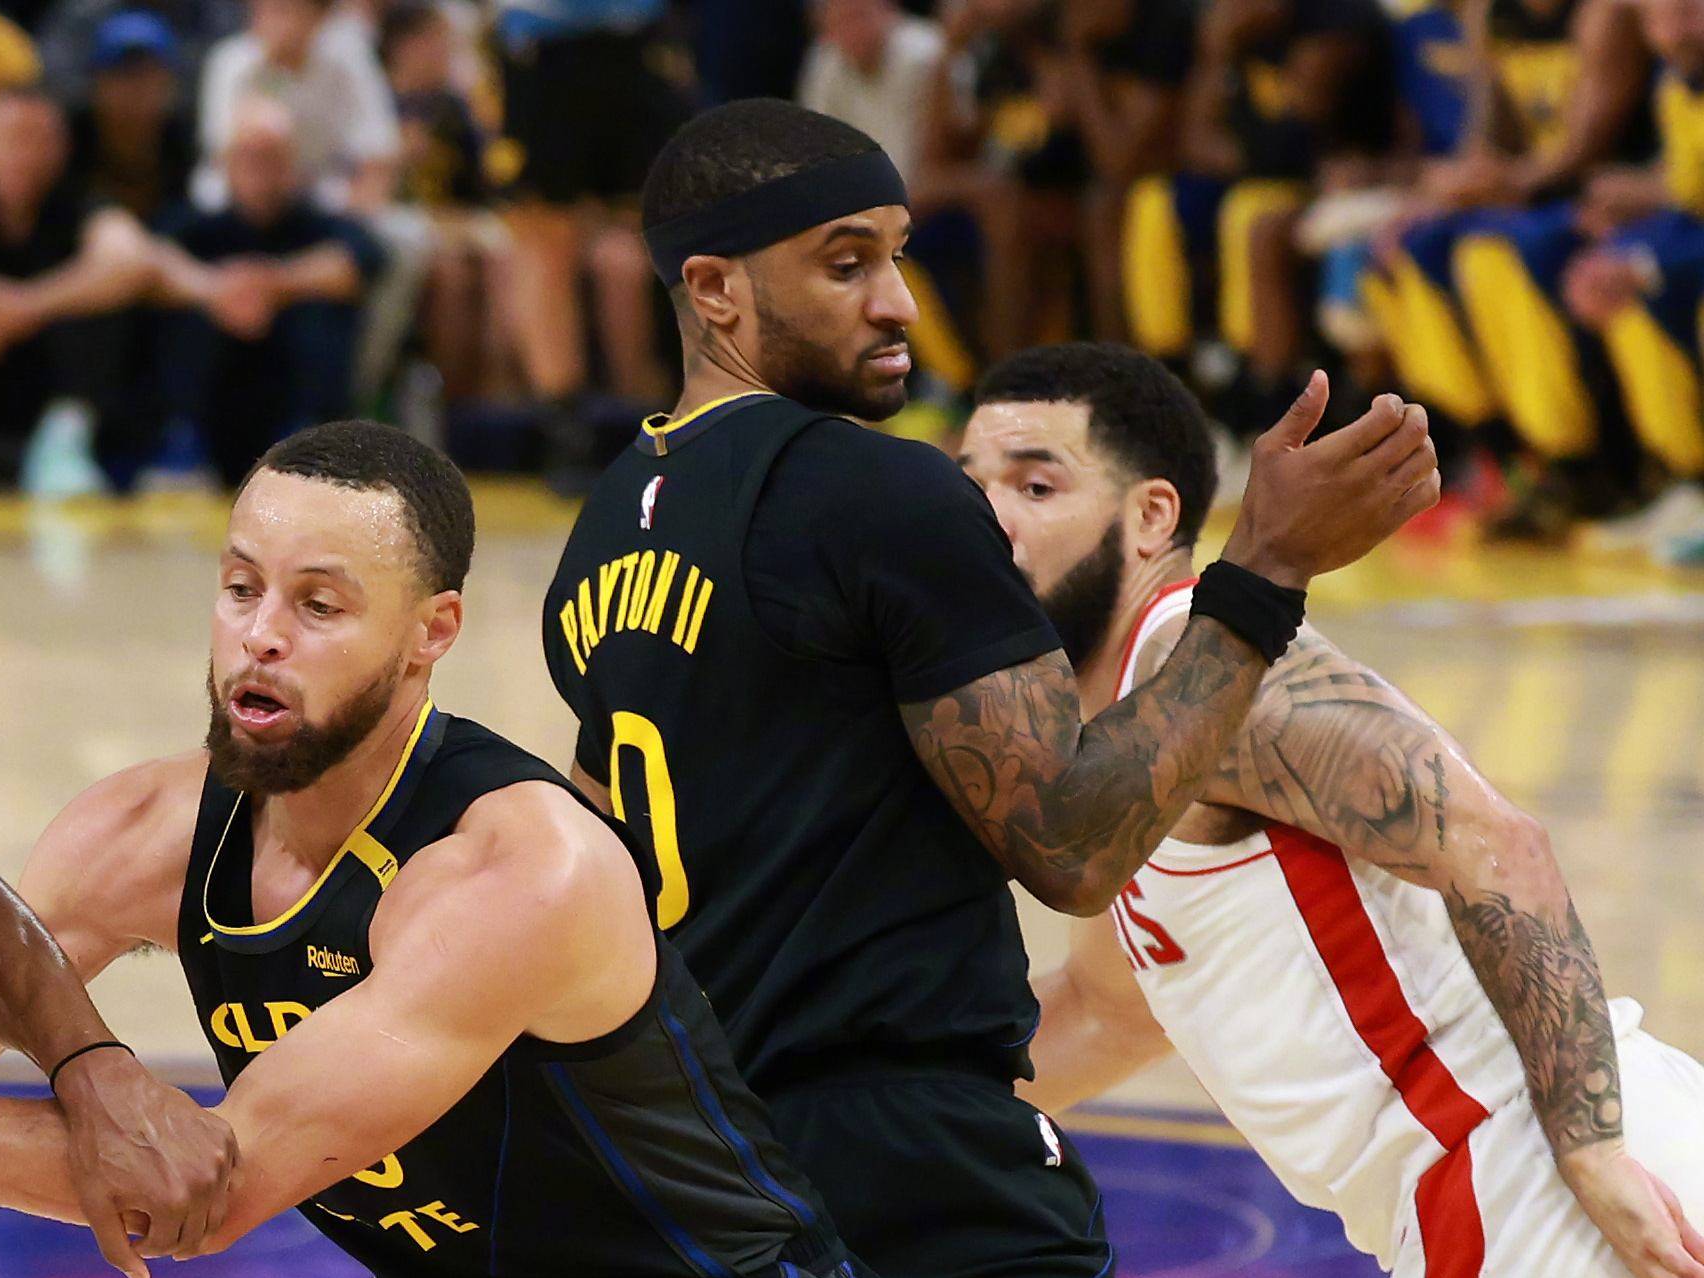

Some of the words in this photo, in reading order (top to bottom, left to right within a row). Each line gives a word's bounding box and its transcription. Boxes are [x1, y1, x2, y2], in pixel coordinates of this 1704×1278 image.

[559, 549, 681, 677] PAYTON
[671, 564, 714, 656] II
[610, 710, 690, 932] 0
[306, 944, 361, 976] Rakuten
